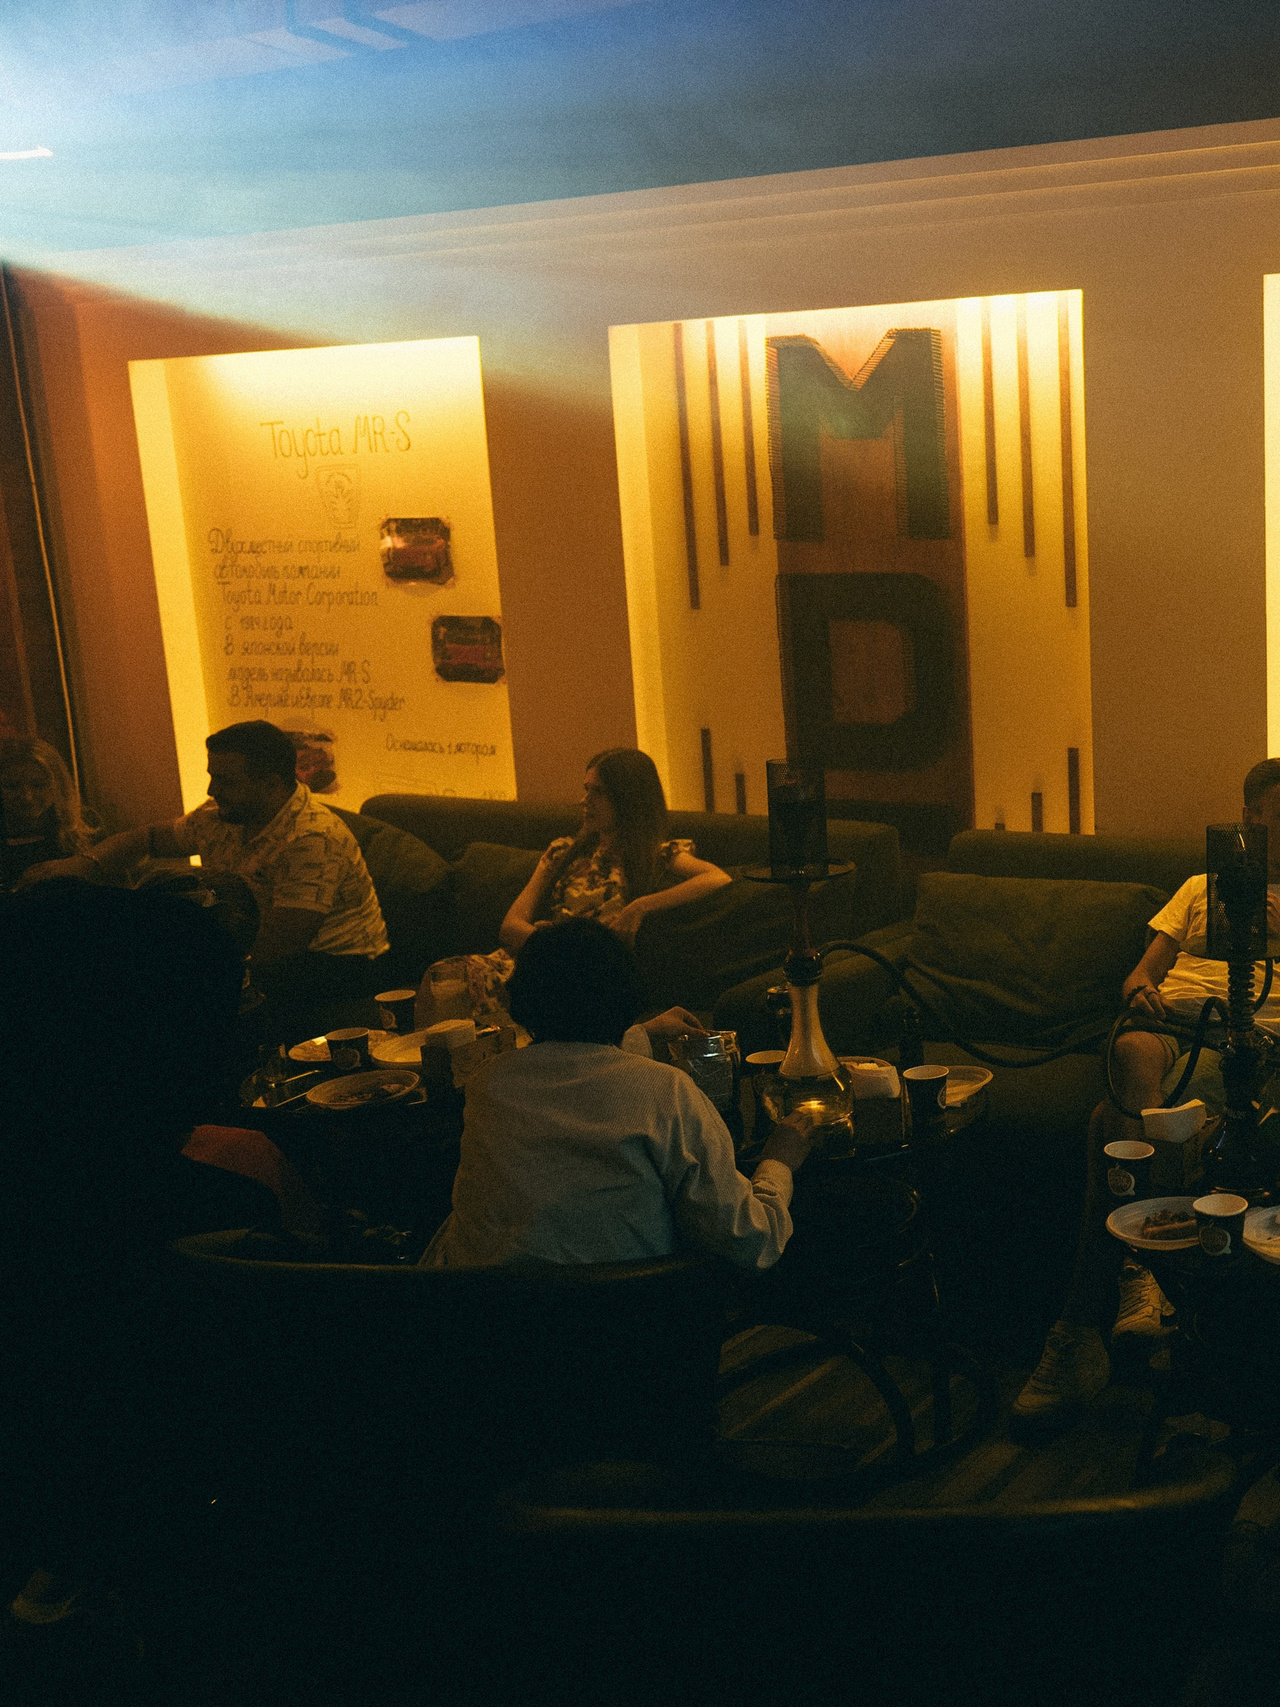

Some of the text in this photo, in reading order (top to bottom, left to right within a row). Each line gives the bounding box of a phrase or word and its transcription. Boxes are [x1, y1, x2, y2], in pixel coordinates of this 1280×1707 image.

[260, 410, 412, 480] Toyota MR-S
[298, 532, 360, 563] спортивный
[217, 580, 378, 613] Toyota Motor Corporation
